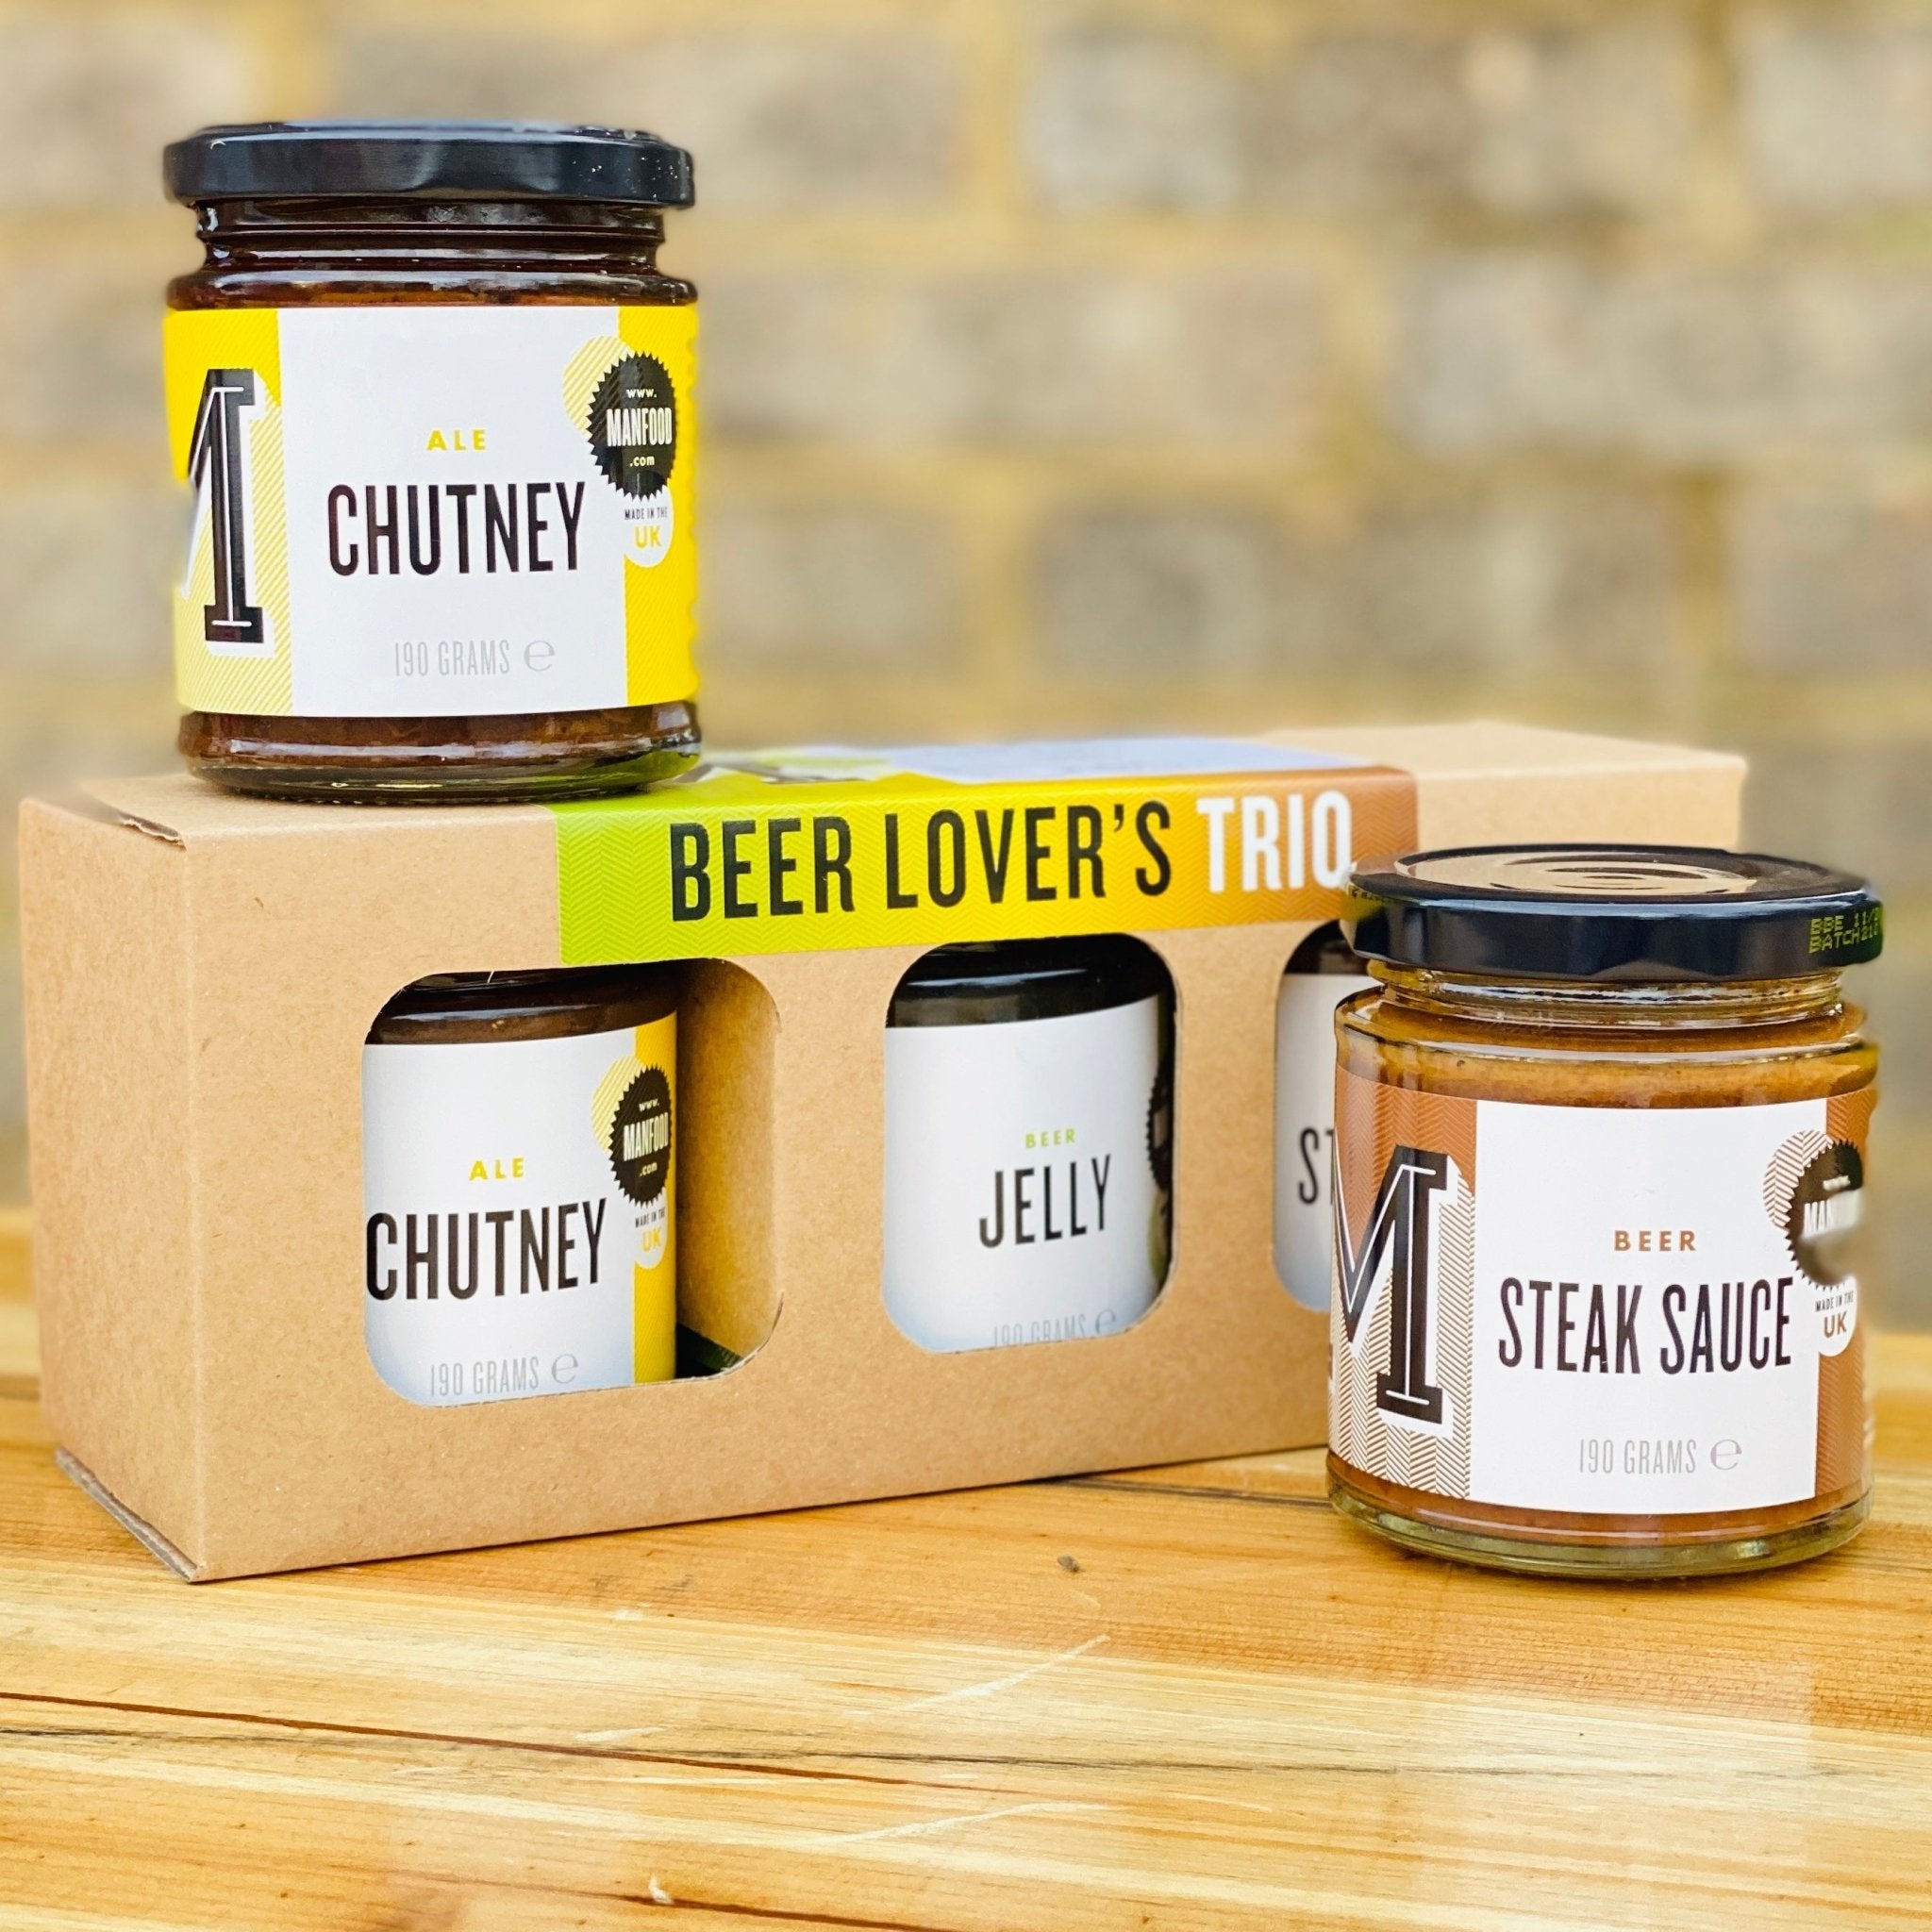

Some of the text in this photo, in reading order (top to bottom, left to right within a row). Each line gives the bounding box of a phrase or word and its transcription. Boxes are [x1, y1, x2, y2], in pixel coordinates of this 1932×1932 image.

[426, 429, 487, 451] ALE
[607, 408, 673, 447] MANFOOD
[629, 455, 656, 467] .com
[327, 481, 586, 575] CHUTNEY
[625, 508, 645, 520] MADE
[647, 508, 655, 519] IN
[634, 525, 661, 548] UK
[394, 641, 428, 677] 190
[439, 640, 510, 676] GRAMS
[670, 789, 1353, 923] BEER LOVER'S TRIO
[1025, 1128, 1075, 1148] BEER
[469, 1158, 525, 1181] ALE
[979, 1154, 1111, 1248] JELLY
[366, 1197, 607, 1301] CHUTNEY
[1614, 1230, 1696, 1252] BEER
[1815, 1293, 1834, 1312] MADE
[1836, 1293, 1842, 1307] IN
[1498, 1276, 1793, 1375] STEAK SAUCE
[1824, 1310, 1847, 1338] UK
[430, 1362, 463, 1396] 190
[473, 1357, 540, 1394] GRAMS
[1579, 1439, 1613, 1474] 190
[1624, 1438, 1696, 1474] GRAMS
